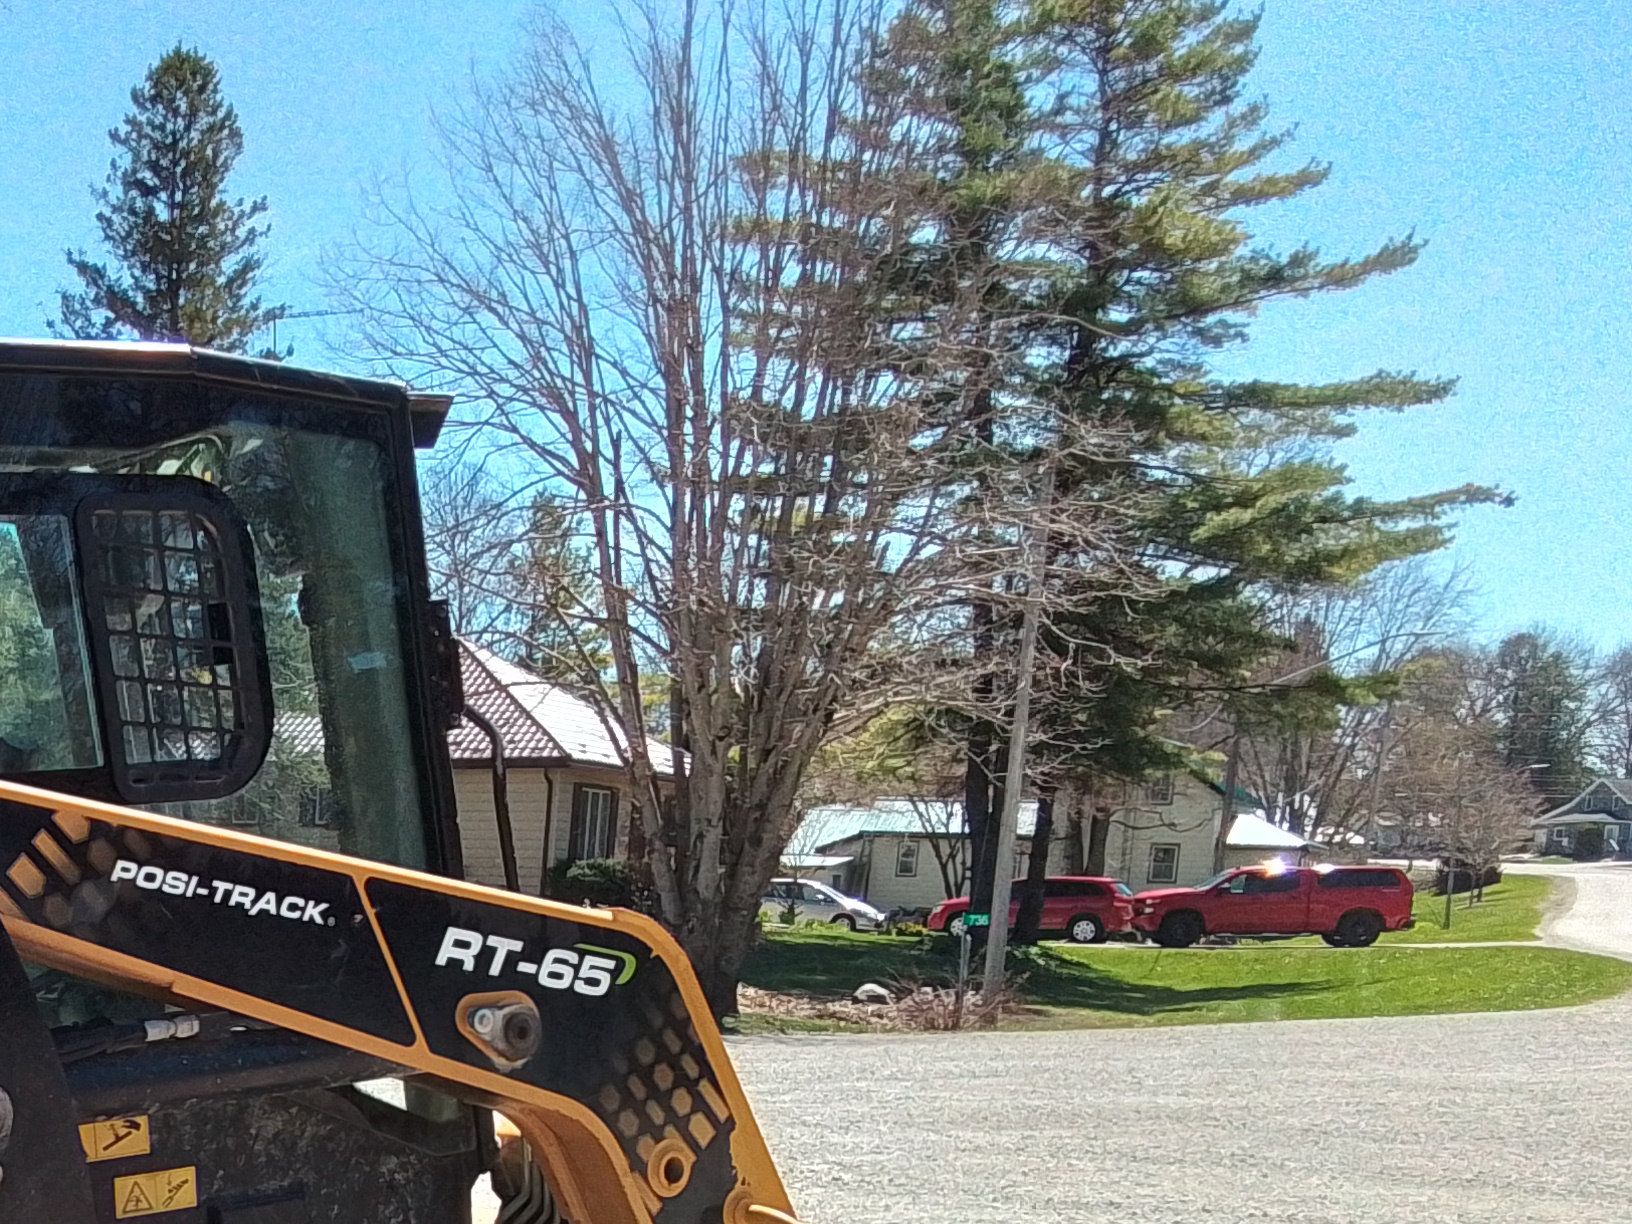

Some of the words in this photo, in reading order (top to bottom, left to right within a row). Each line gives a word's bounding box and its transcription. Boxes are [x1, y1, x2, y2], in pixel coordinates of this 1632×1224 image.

[110, 859, 330, 925] POSI-TRACK
[969, 914, 989, 926] 736
[434, 926, 617, 996] RT-65
